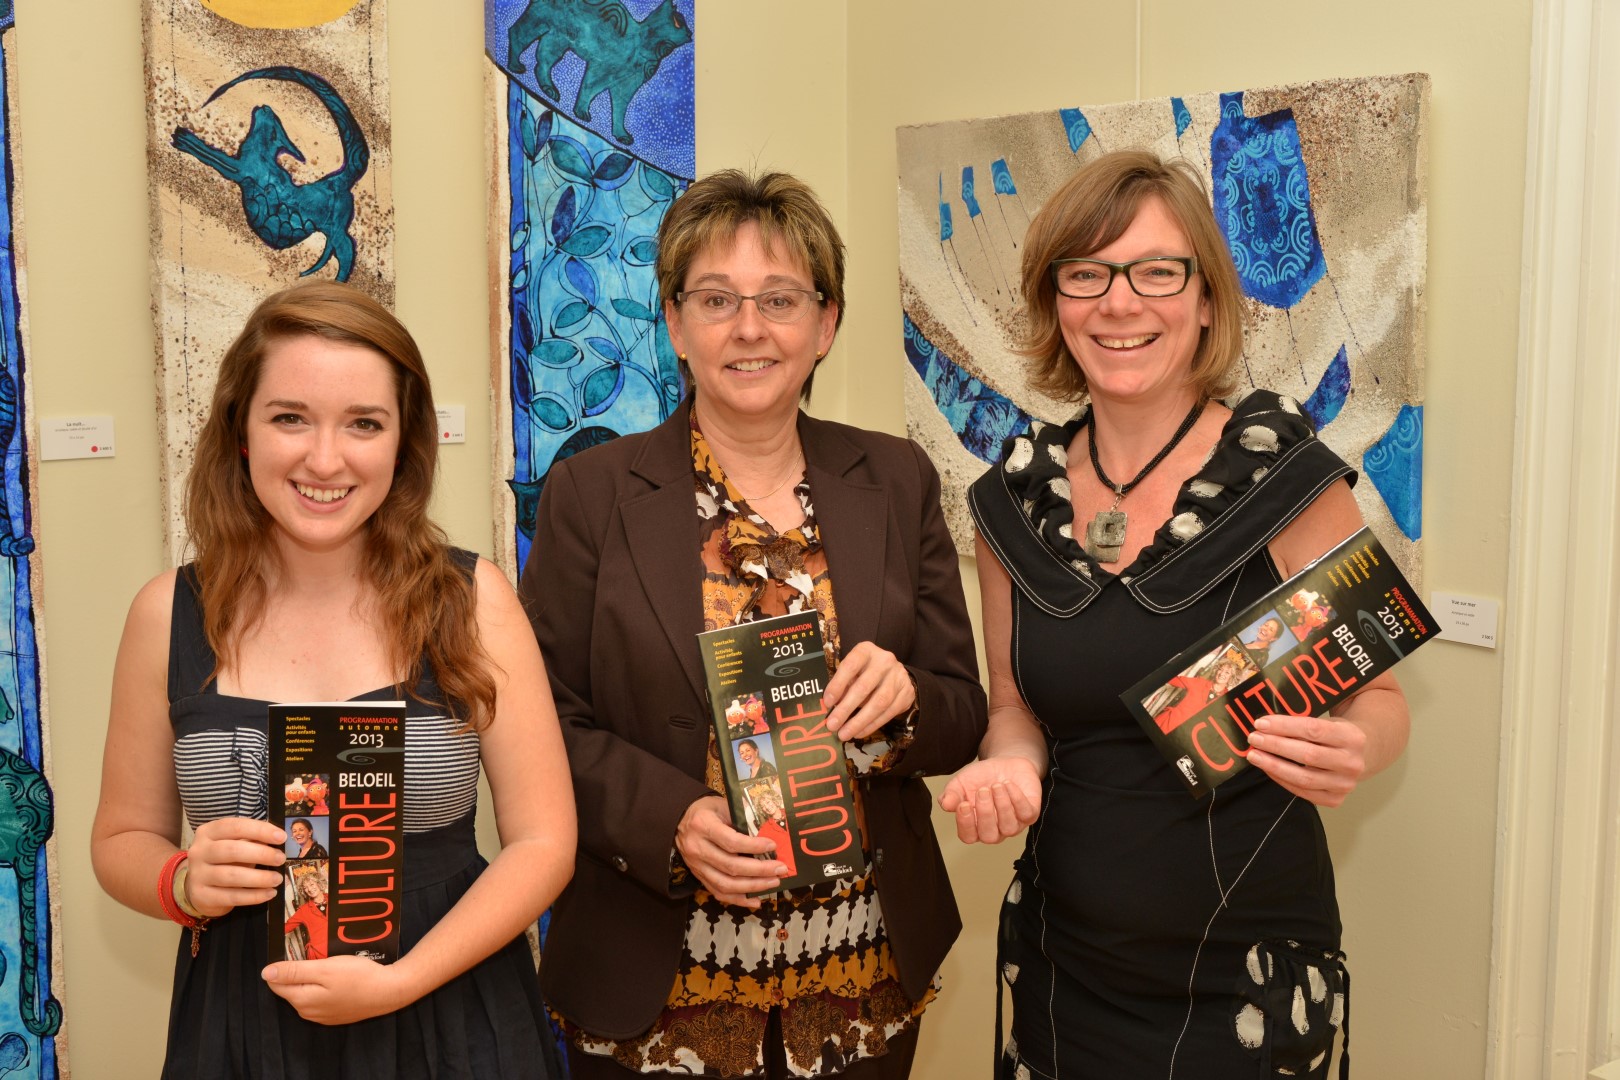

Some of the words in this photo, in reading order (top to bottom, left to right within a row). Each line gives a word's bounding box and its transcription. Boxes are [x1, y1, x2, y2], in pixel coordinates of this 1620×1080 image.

[1392, 587, 1427, 634] PROGRAMMATION
[760, 623, 812, 639] PROGRAMMATION
[1377, 606, 1404, 639] 2013
[762, 630, 814, 646] automne
[772, 642, 804, 658] 2013
[1332, 624, 1374, 676] BELOEIL
[770, 679, 823, 702] BELOEIL
[350, 734, 384, 748] 2013
[338, 773, 396, 788] BELOEIL
[775, 698, 852, 856] CULTURE
[337, 793, 396, 944] CULTURE
